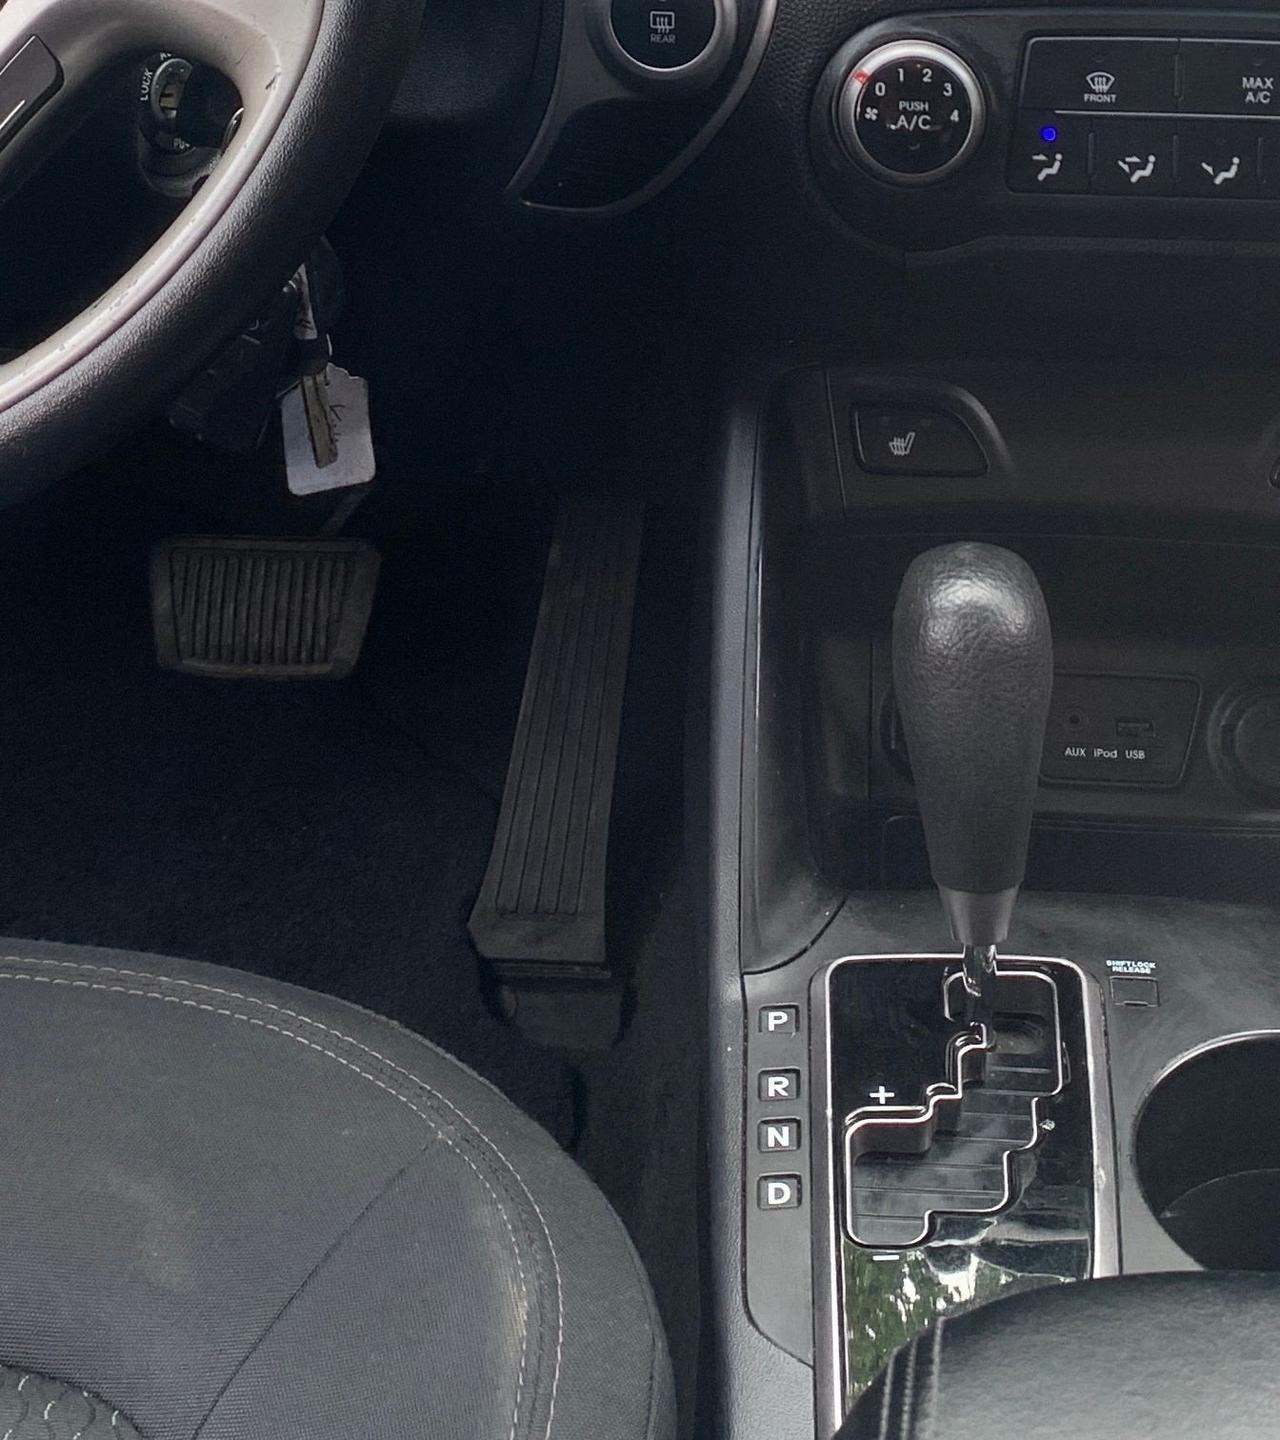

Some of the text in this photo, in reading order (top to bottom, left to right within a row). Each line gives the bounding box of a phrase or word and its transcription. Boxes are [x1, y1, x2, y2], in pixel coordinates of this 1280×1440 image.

[650, 34, 675, 43] REAR
[898, 68, 904, 82] 1
[922, 68, 932, 82] 2
[875, 82, 886, 96] 0
[943, 83, 952, 96] 3
[1242, 77, 1274, 89] MAX
[1084, 94, 1117, 103] FRONT
[1245, 92, 1270, 104] A/C
[899, 101, 928, 111] PUSH
[950, 109, 959, 122] 4
[897, 115, 931, 131] A/C
[1065, 747, 1145, 759] AUX iPod USB
[768, 1013, 788, 1031] P
[768, 1077, 789, 1097] R
[768, 1127, 789, 1147] N
[768, 1183, 791, 1203] D
